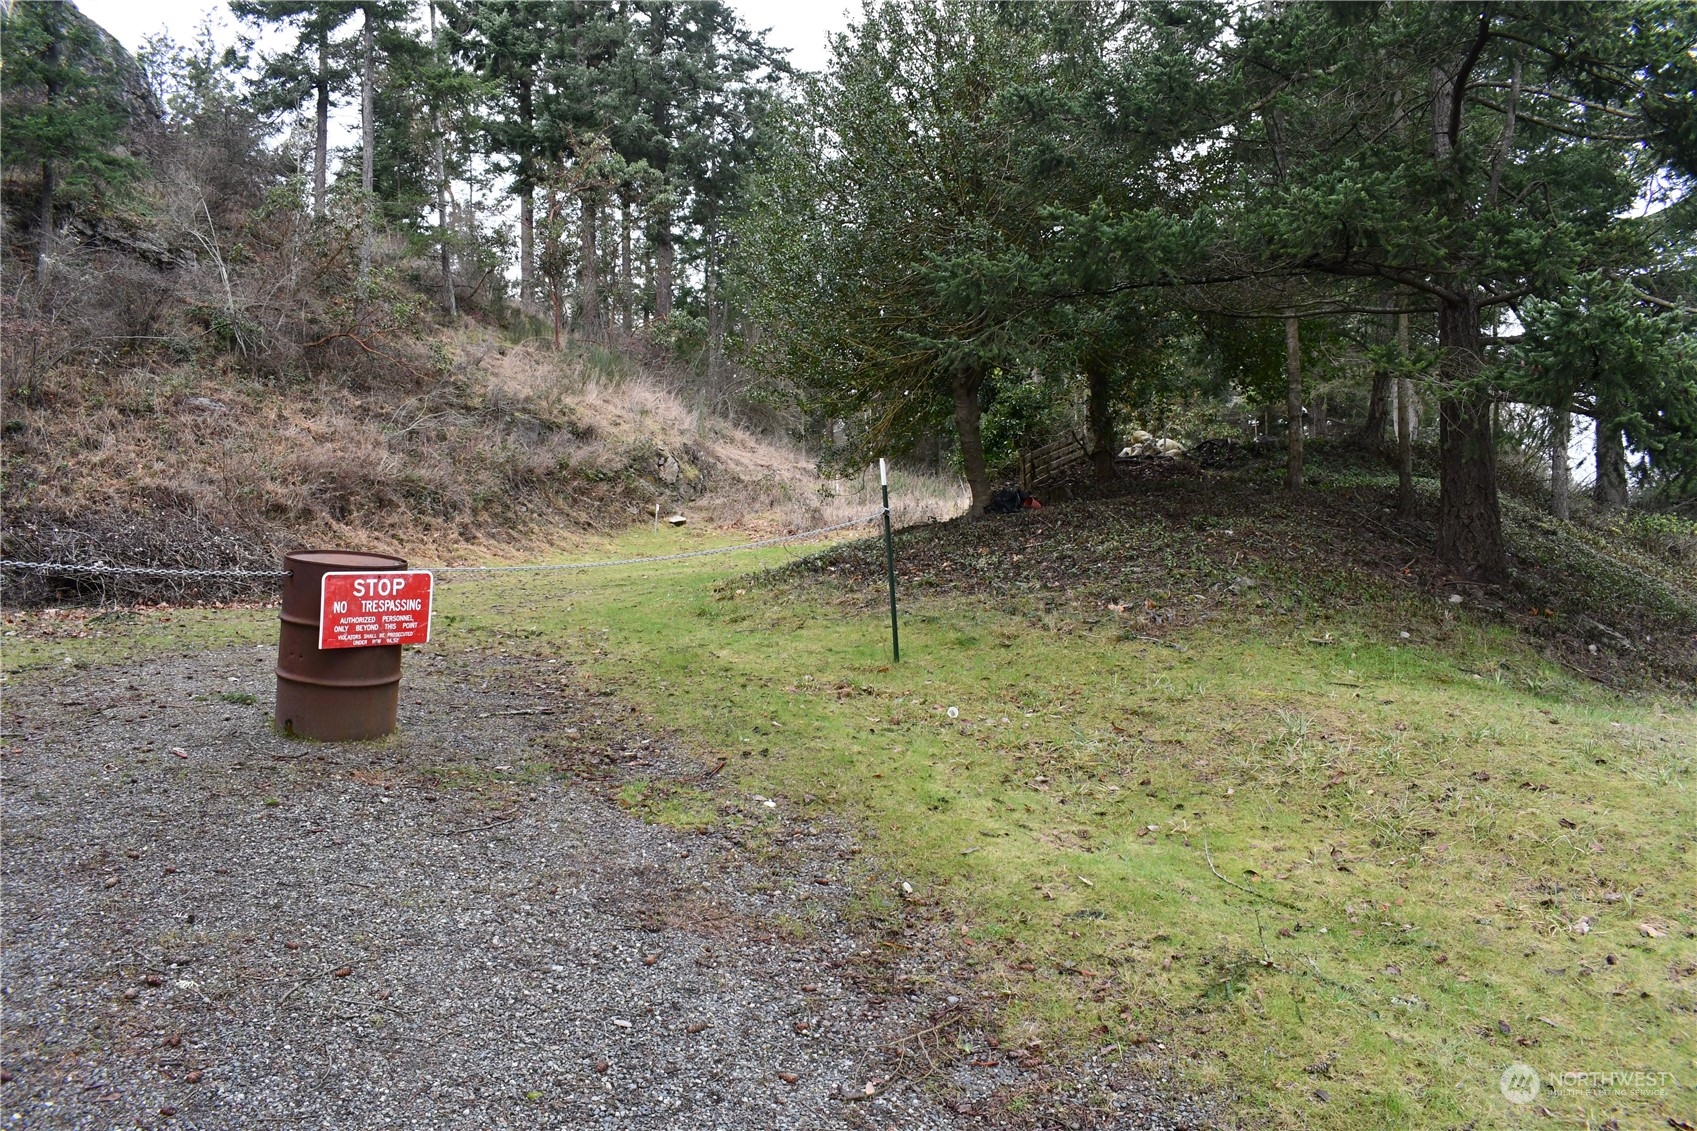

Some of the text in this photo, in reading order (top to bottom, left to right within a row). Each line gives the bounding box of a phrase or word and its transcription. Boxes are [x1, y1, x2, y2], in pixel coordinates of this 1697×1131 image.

[353, 578, 405, 597] STOP
[333, 599, 421, 614] NO TRESPASSING
[340, 616, 376, 624] AUTHORIZED
[334, 625, 349, 633] ONLY
[355, 624, 379, 632] BEYOND
[338, 633, 361, 641] VIOLATORS
